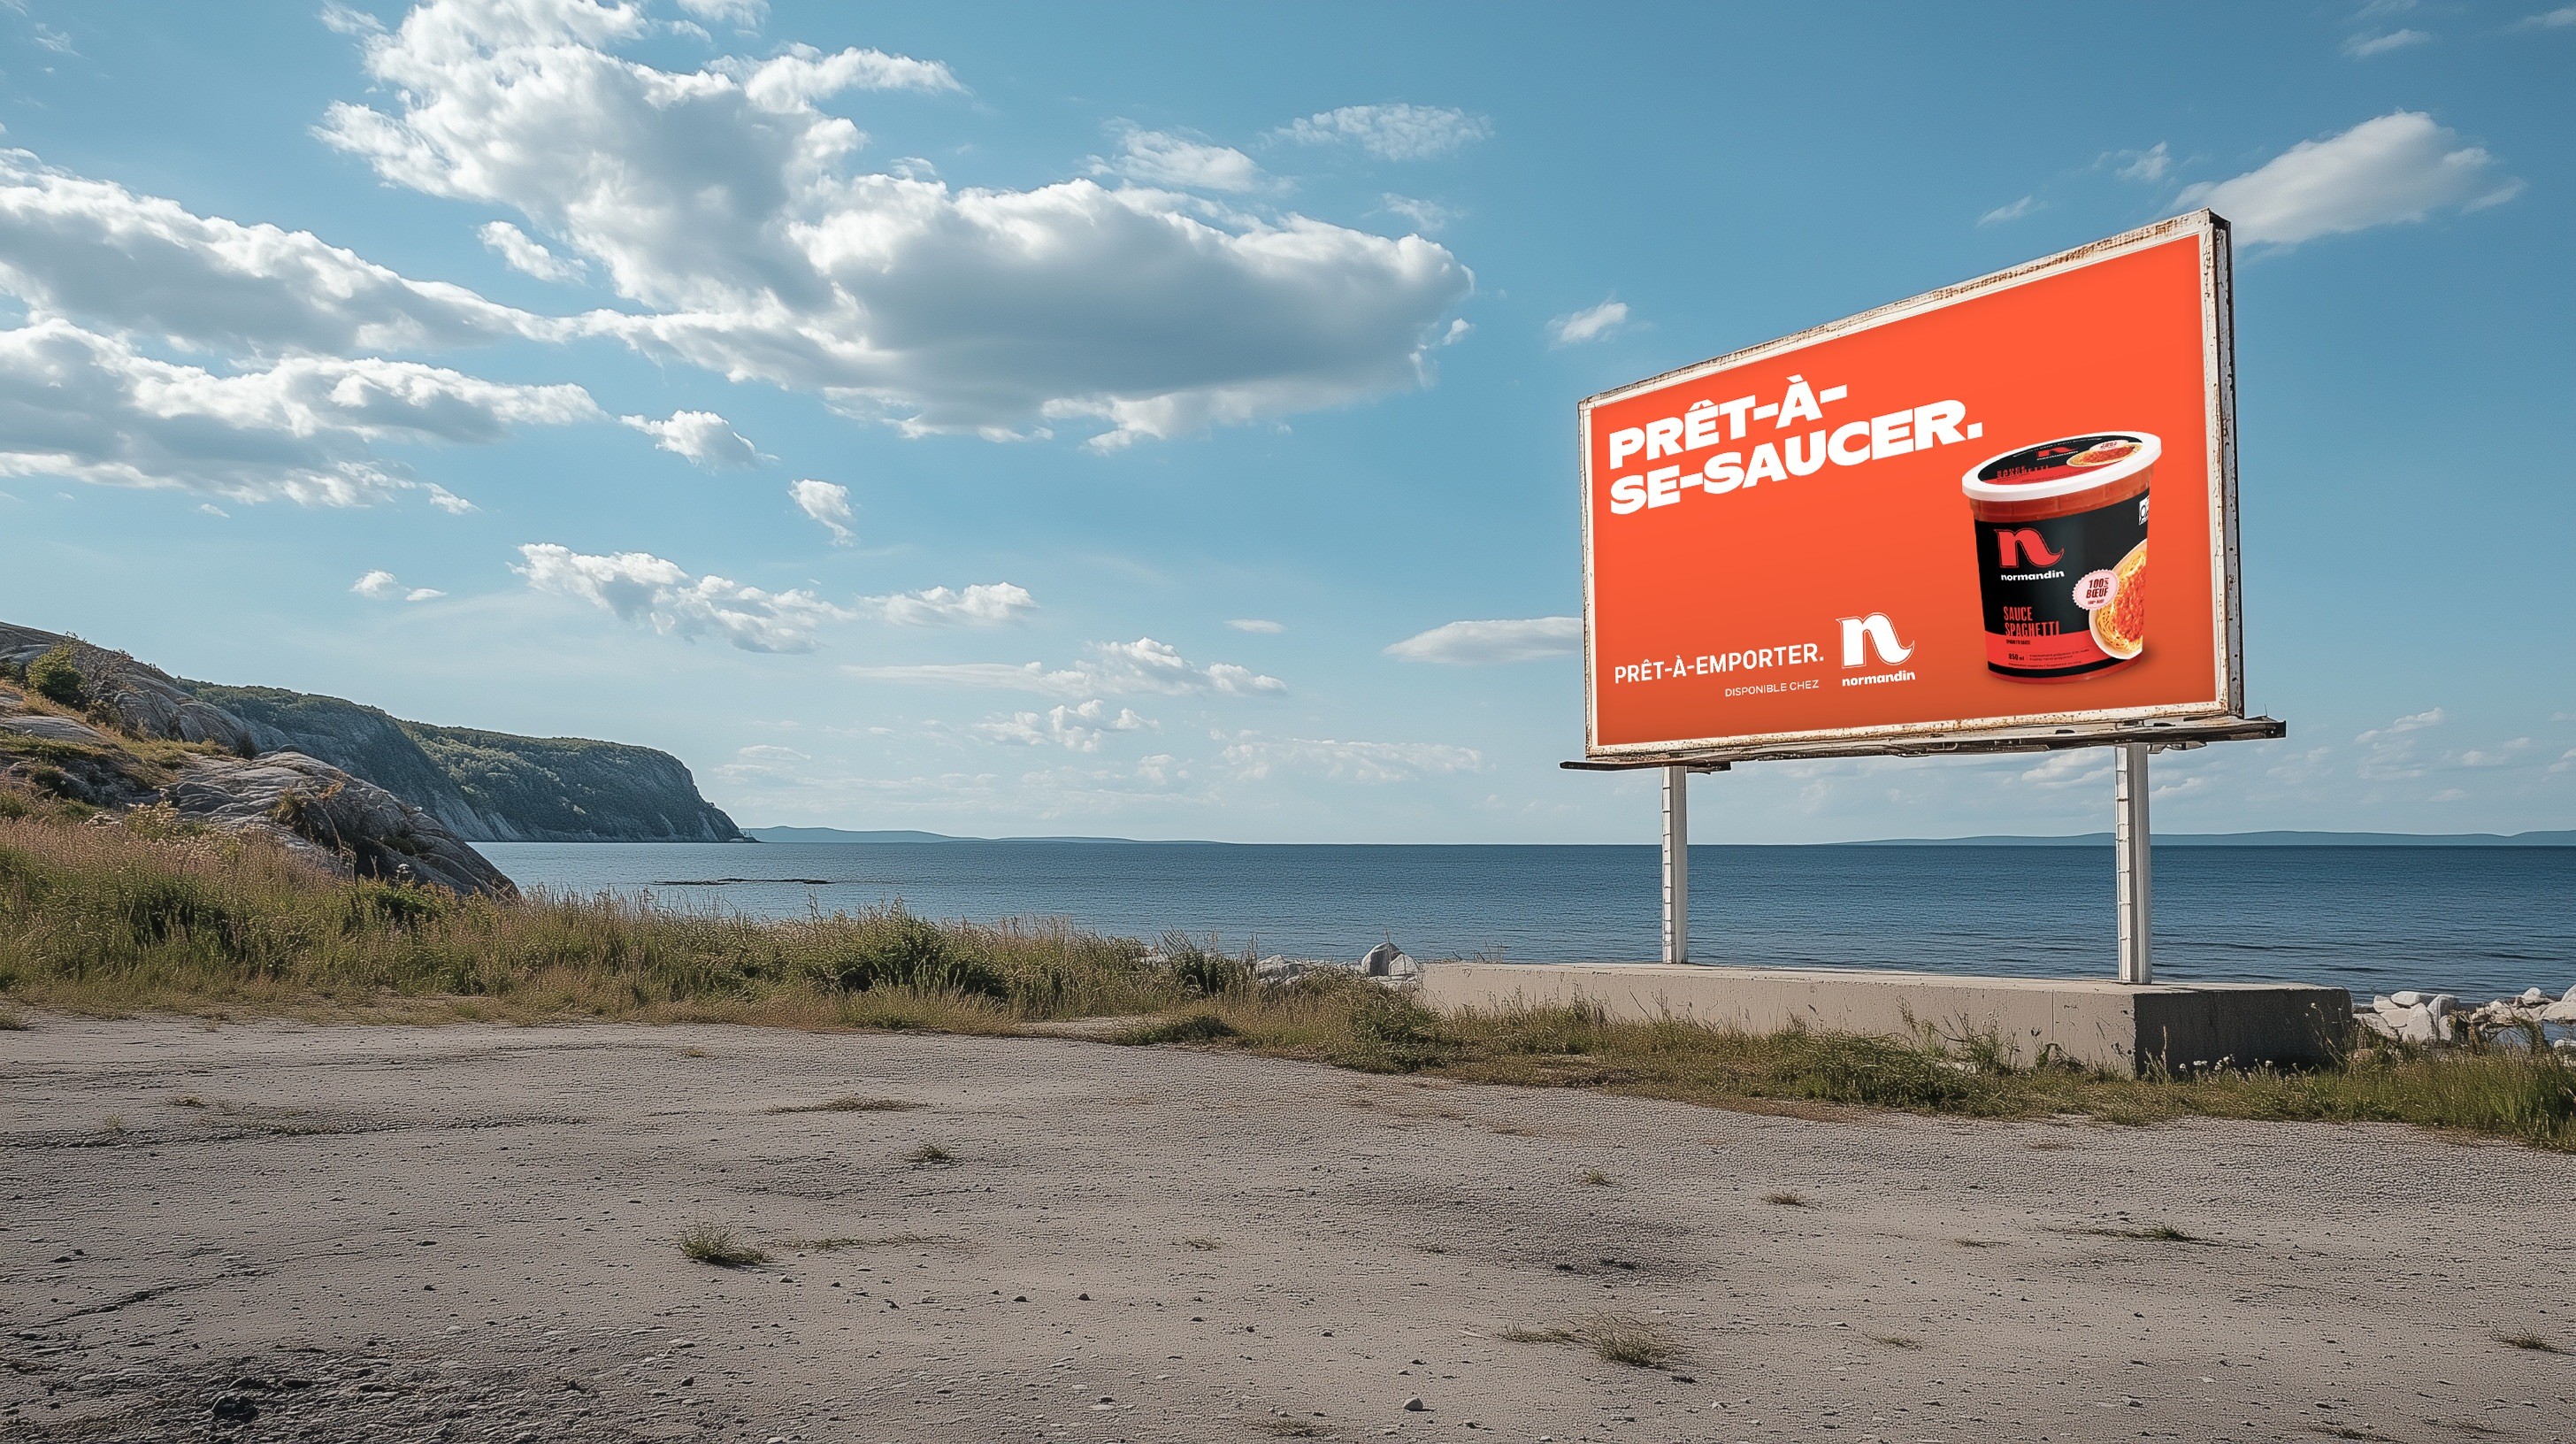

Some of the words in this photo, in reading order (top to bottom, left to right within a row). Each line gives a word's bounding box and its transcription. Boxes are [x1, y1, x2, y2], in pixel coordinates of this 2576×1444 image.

[1609, 374, 1847, 470] PRÊT-À-
[1610, 399, 1983, 515] SE-SAUCER.
[2001, 569, 2065, 580] normandin
[2086, 588, 2109, 598] BŒUF
[2003, 606, 2033, 621] SAUCE
[2005, 621, 2060, 636] SPAGHETTI
[1614, 642, 1824, 684] PRÊT-À-EMPORTER.
[1842, 670, 1916, 687] normandin
[1725, 683, 1787, 697] DISPONIBLE
[1790, 680, 1820, 691] CHEZ
